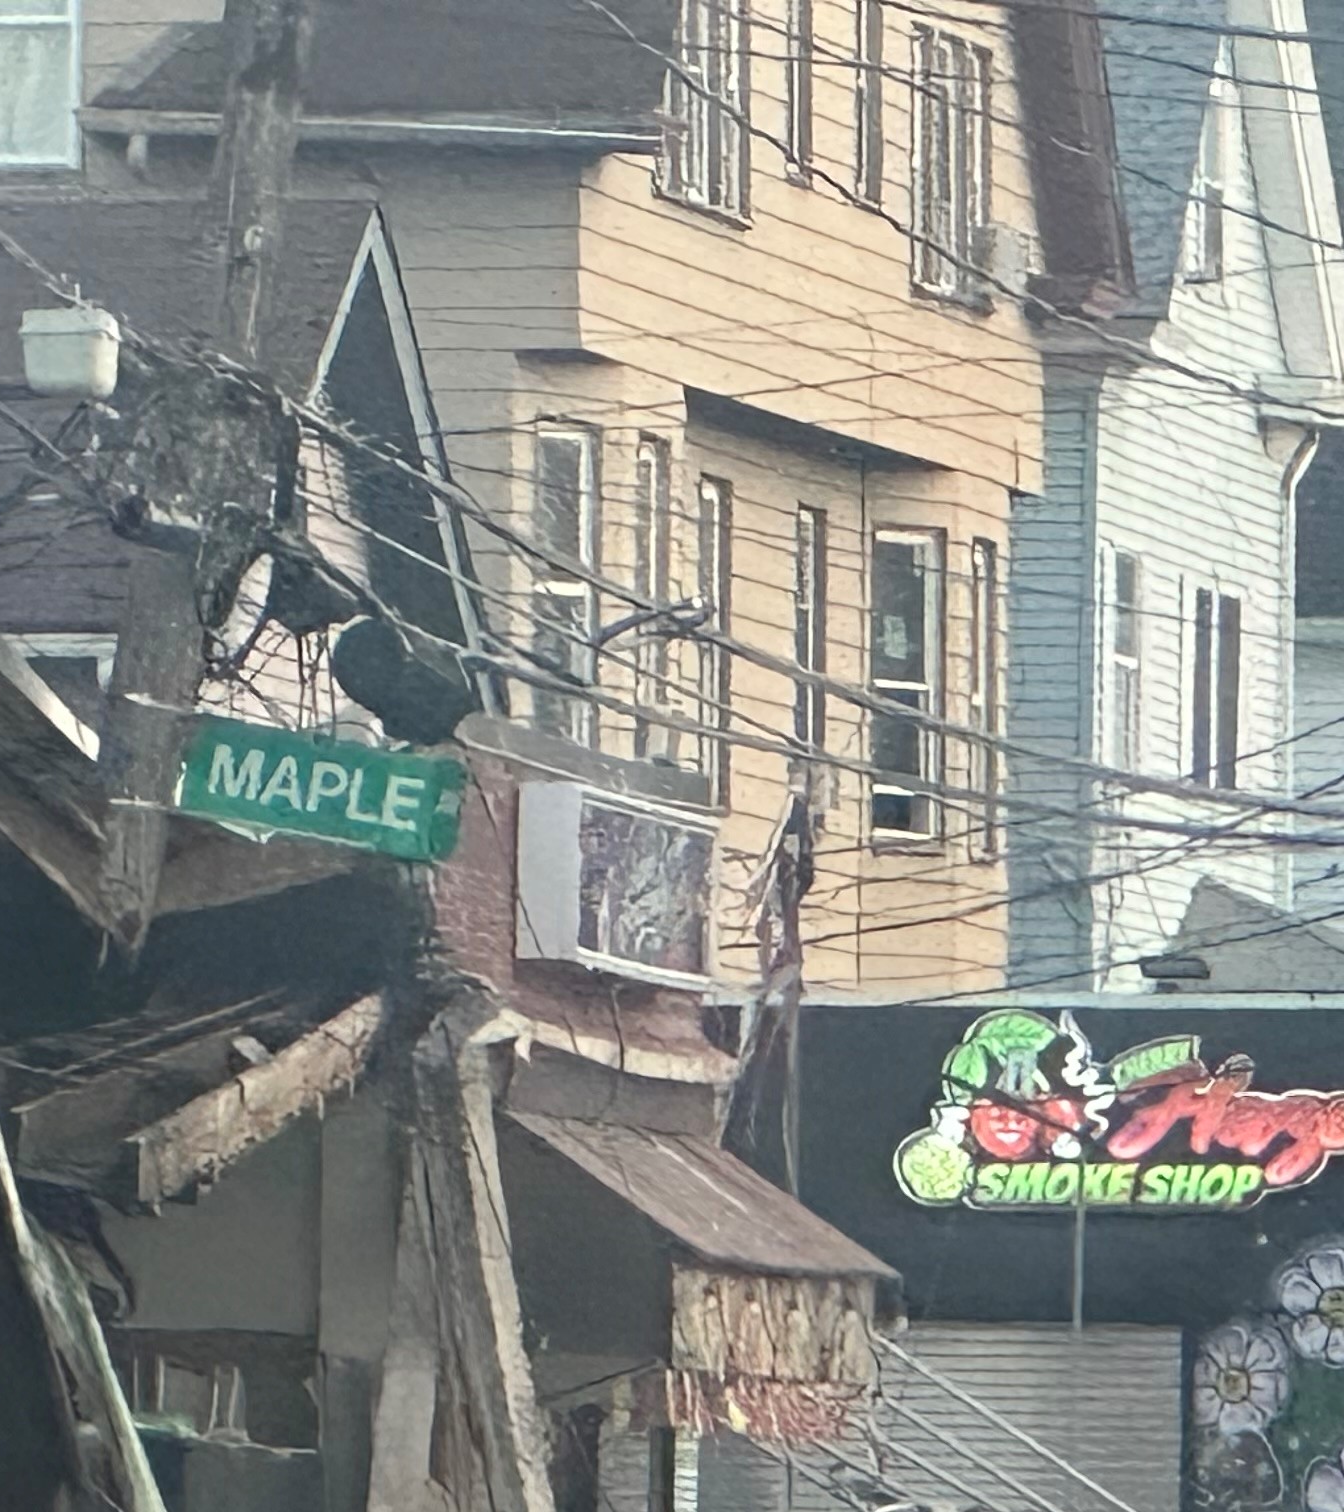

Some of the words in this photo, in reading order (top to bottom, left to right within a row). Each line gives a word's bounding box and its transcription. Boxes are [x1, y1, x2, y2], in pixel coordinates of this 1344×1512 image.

[208, 743, 426, 832] MAPLE
[974, 1161, 1140, 1204] SMOKE
[1140, 1162, 1265, 1204] SHOP
